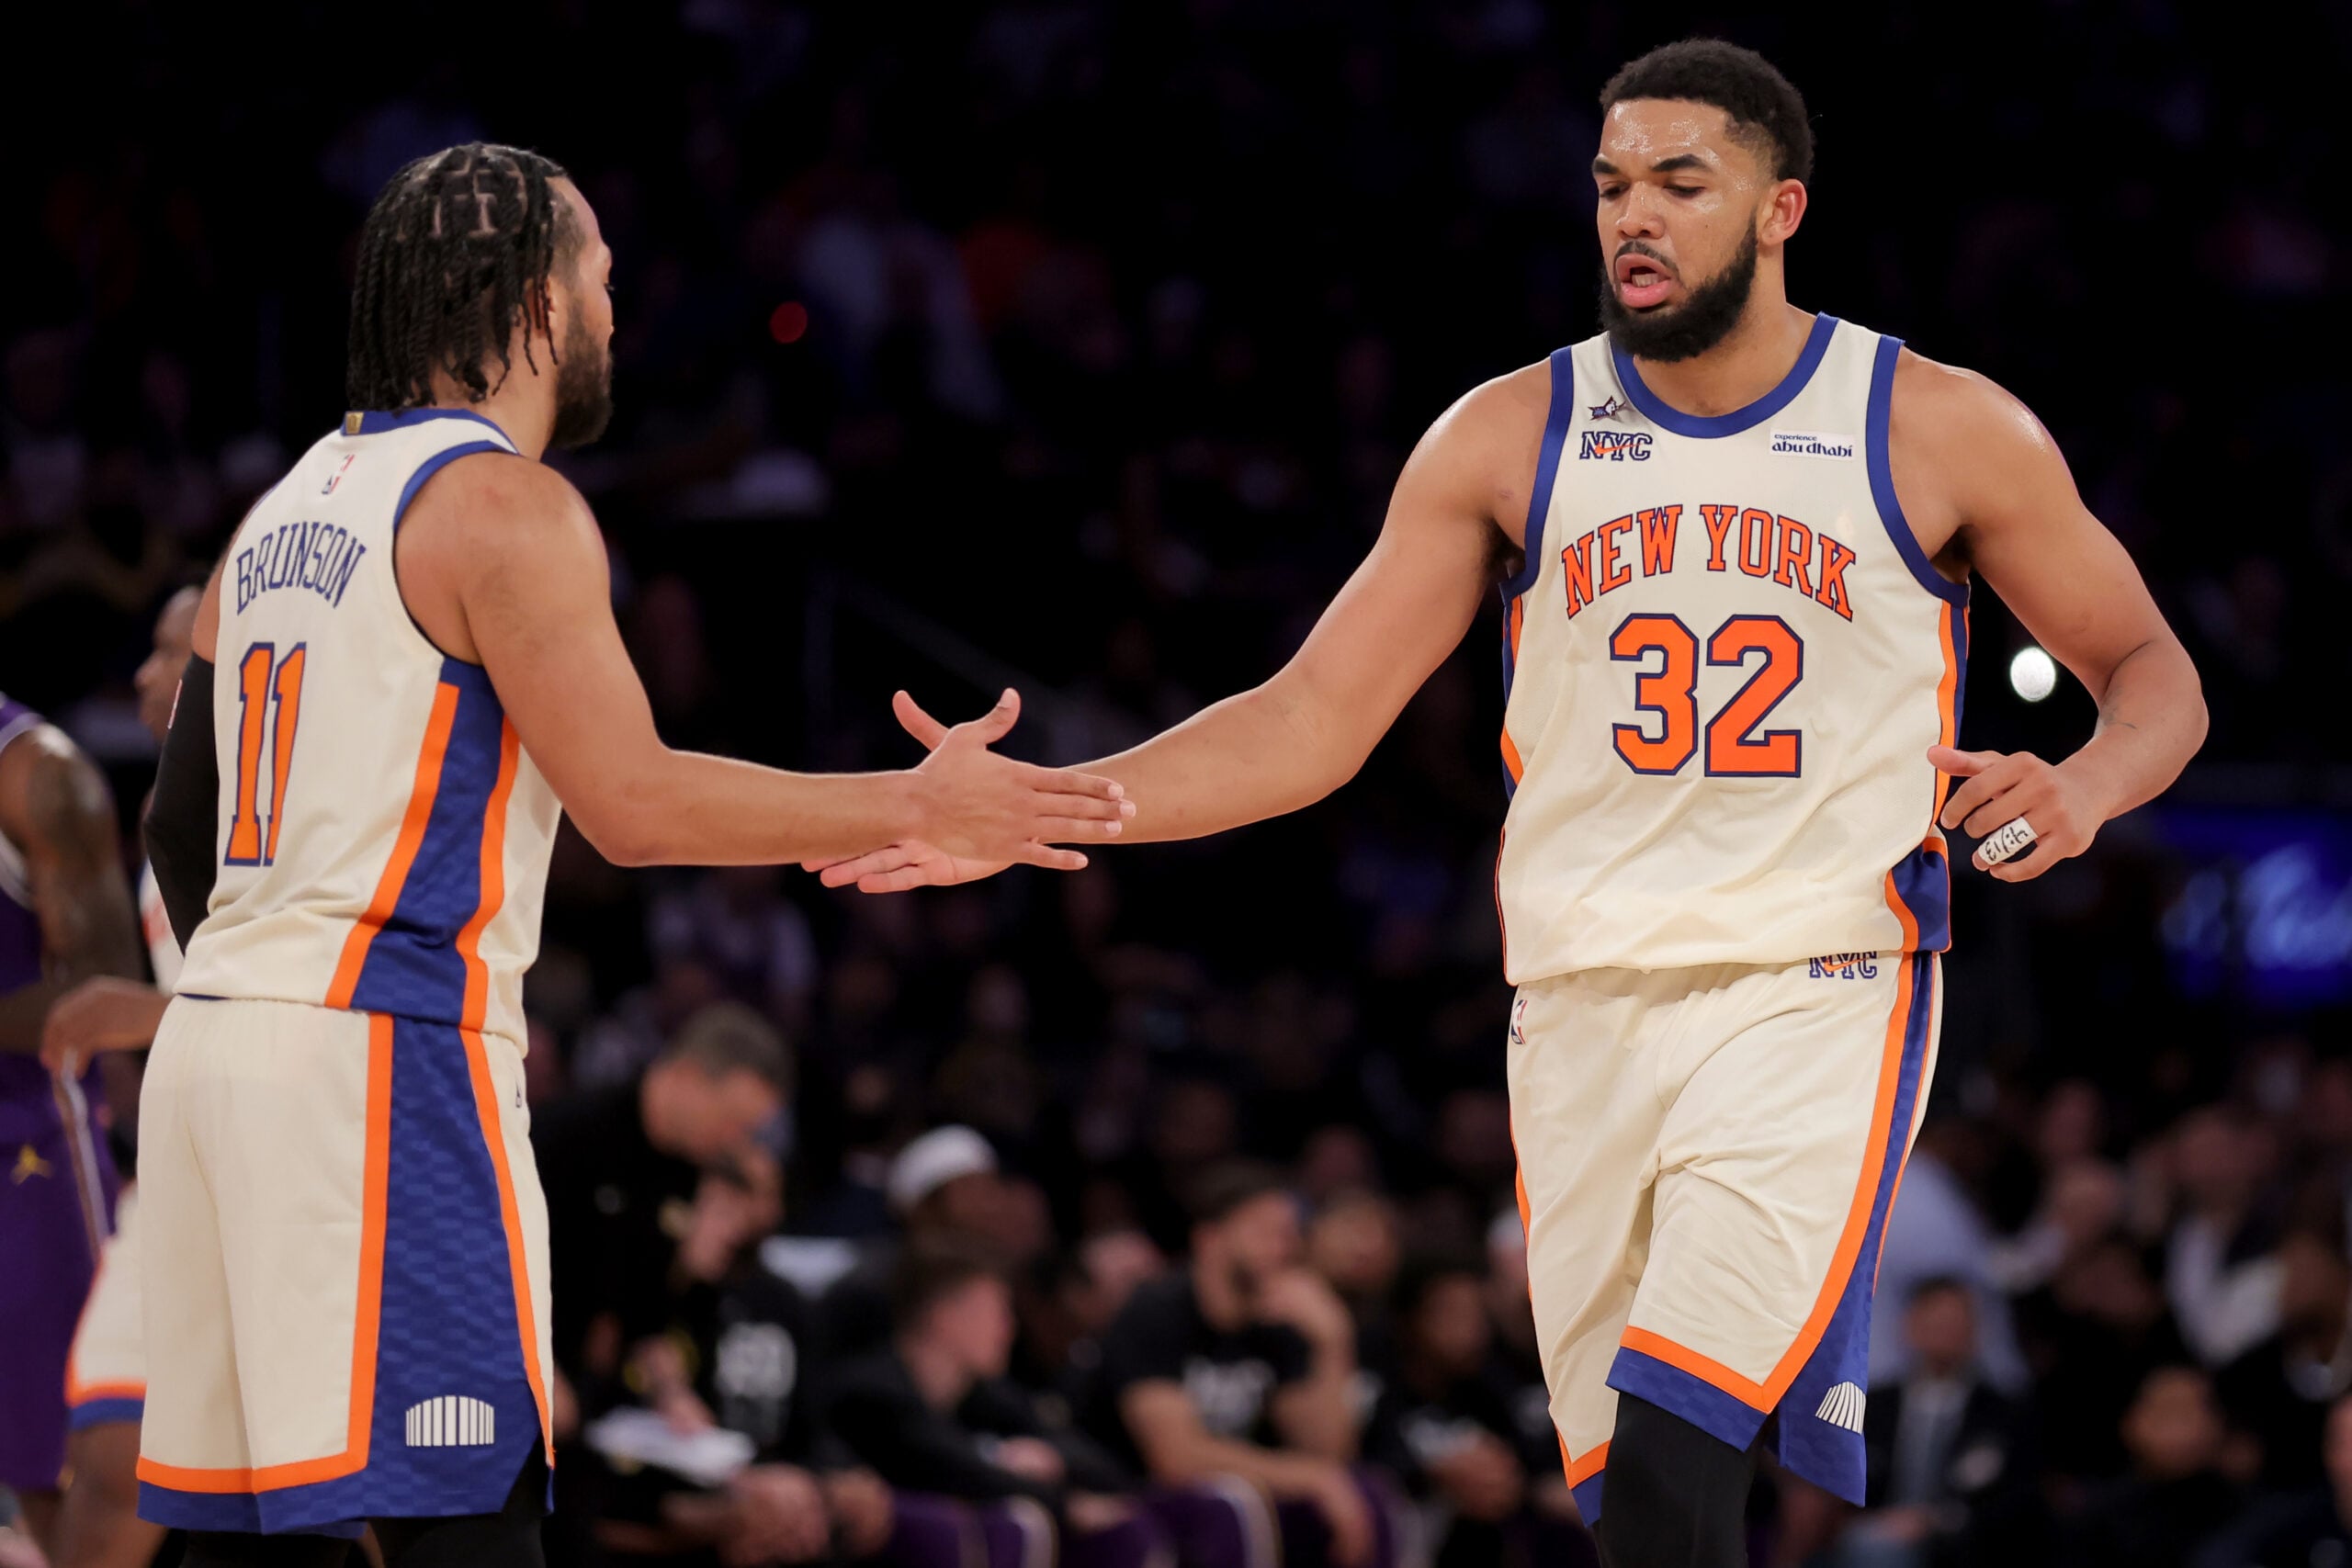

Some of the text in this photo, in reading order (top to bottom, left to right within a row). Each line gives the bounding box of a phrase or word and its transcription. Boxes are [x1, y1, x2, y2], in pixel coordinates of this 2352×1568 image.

[1579, 431, 1653, 461] NYC
[1772, 441, 1852, 457] abu dhabi
[237, 521, 366, 615] BRUNSON
[1562, 504, 1856, 622] NEW YORK
[1609, 614, 1804, 777] 32
[224, 642, 306, 866] 11
[1809, 951, 1877, 979] NYC
